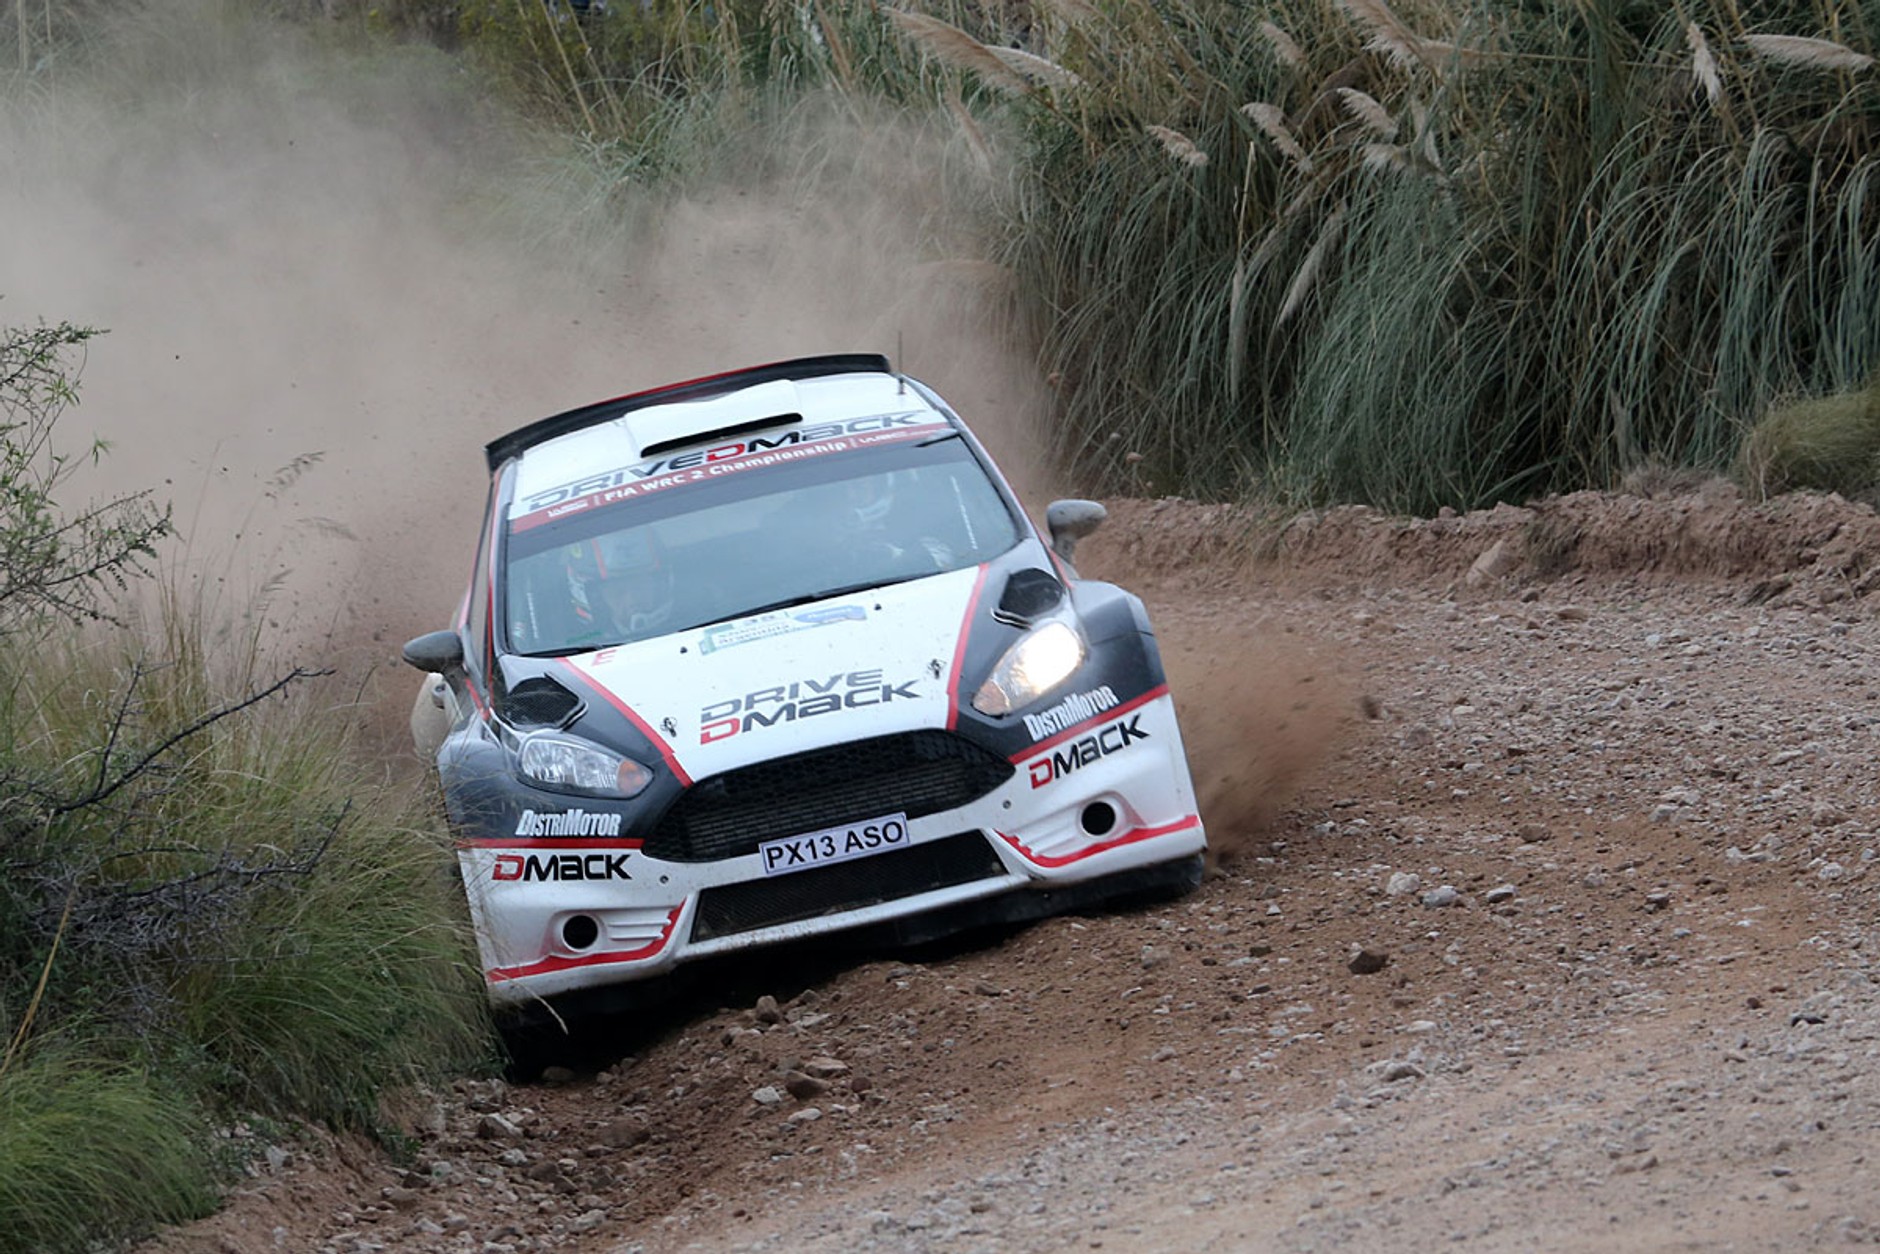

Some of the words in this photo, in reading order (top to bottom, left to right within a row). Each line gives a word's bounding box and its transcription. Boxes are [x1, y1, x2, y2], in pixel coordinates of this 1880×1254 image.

[604, 486, 639, 501] FIA
[641, 474, 687, 491] WRC
[691, 467, 705, 480] 2
[709, 440, 846, 475] Championship
[701, 669, 883, 723] DRIVE
[701, 679, 921, 745] DMACK
[1029, 713, 1150, 790] DMACK
[492, 854, 632, 881] DMACK
[766, 835, 836, 869] PX13
[845, 821, 903, 853] ASO
